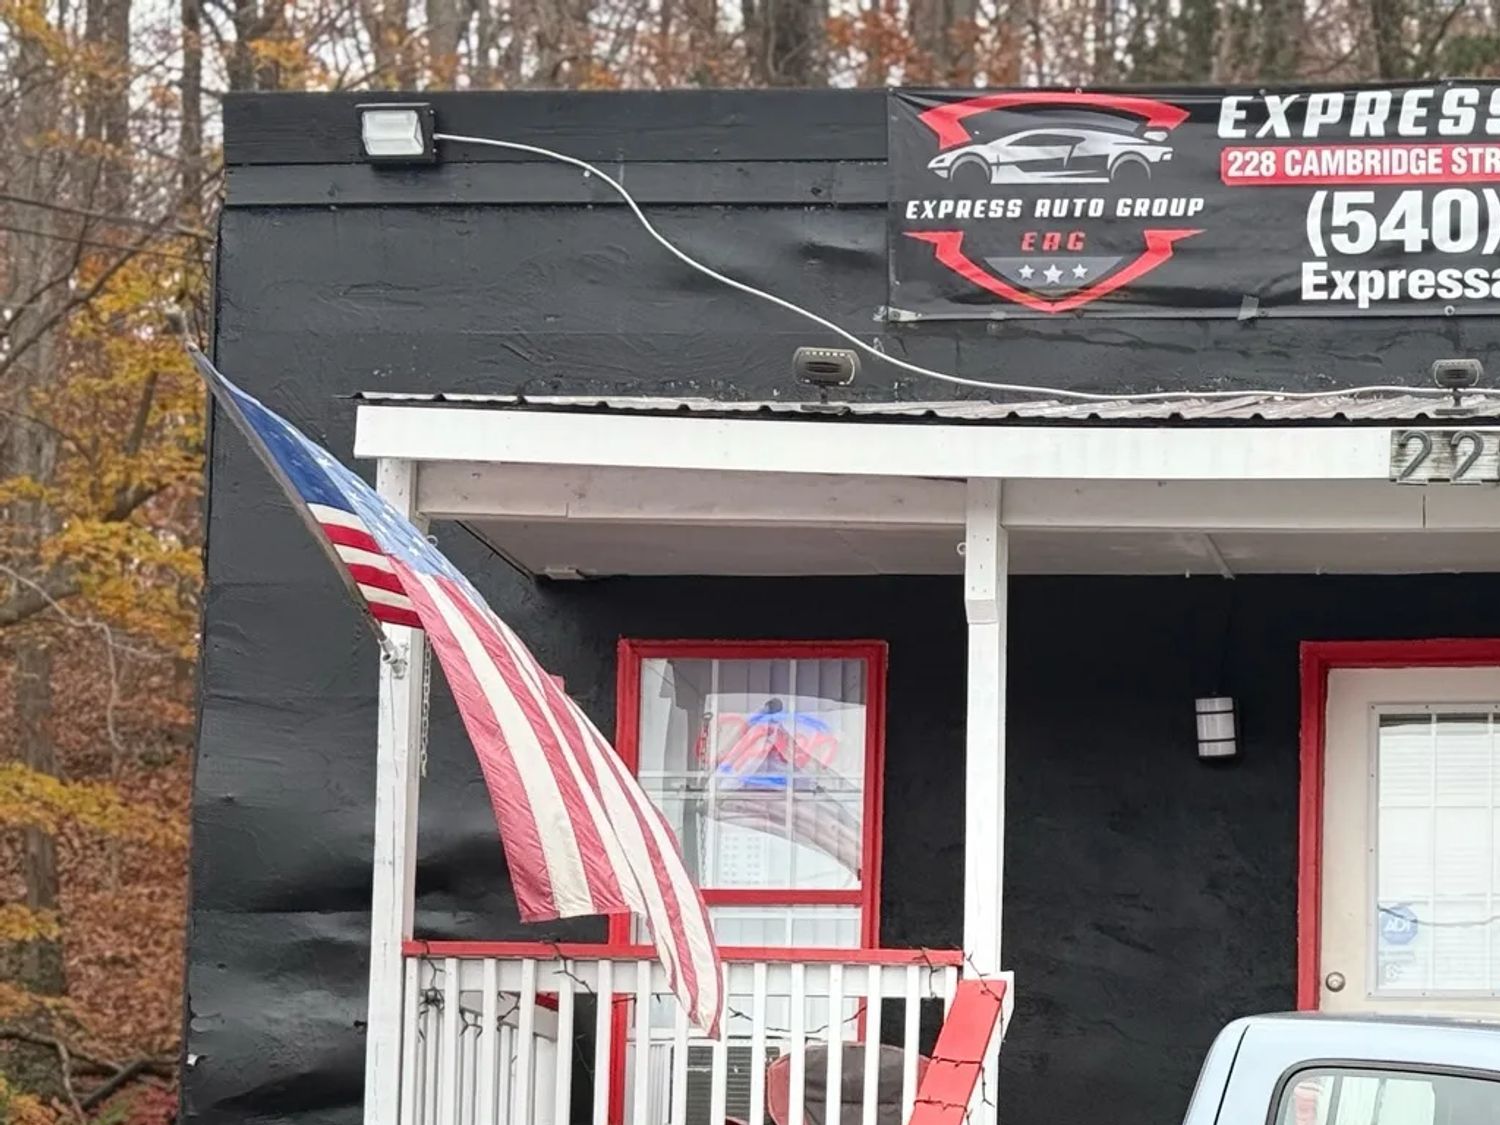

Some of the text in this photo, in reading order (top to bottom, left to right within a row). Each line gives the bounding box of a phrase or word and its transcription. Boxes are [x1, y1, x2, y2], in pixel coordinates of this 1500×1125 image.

[1228, 149, 1276, 178] 228
[1284, 146, 1444, 177] CAMBRIDGE
[905, 197, 1204, 220] EXPRESS AUTO GROUP
